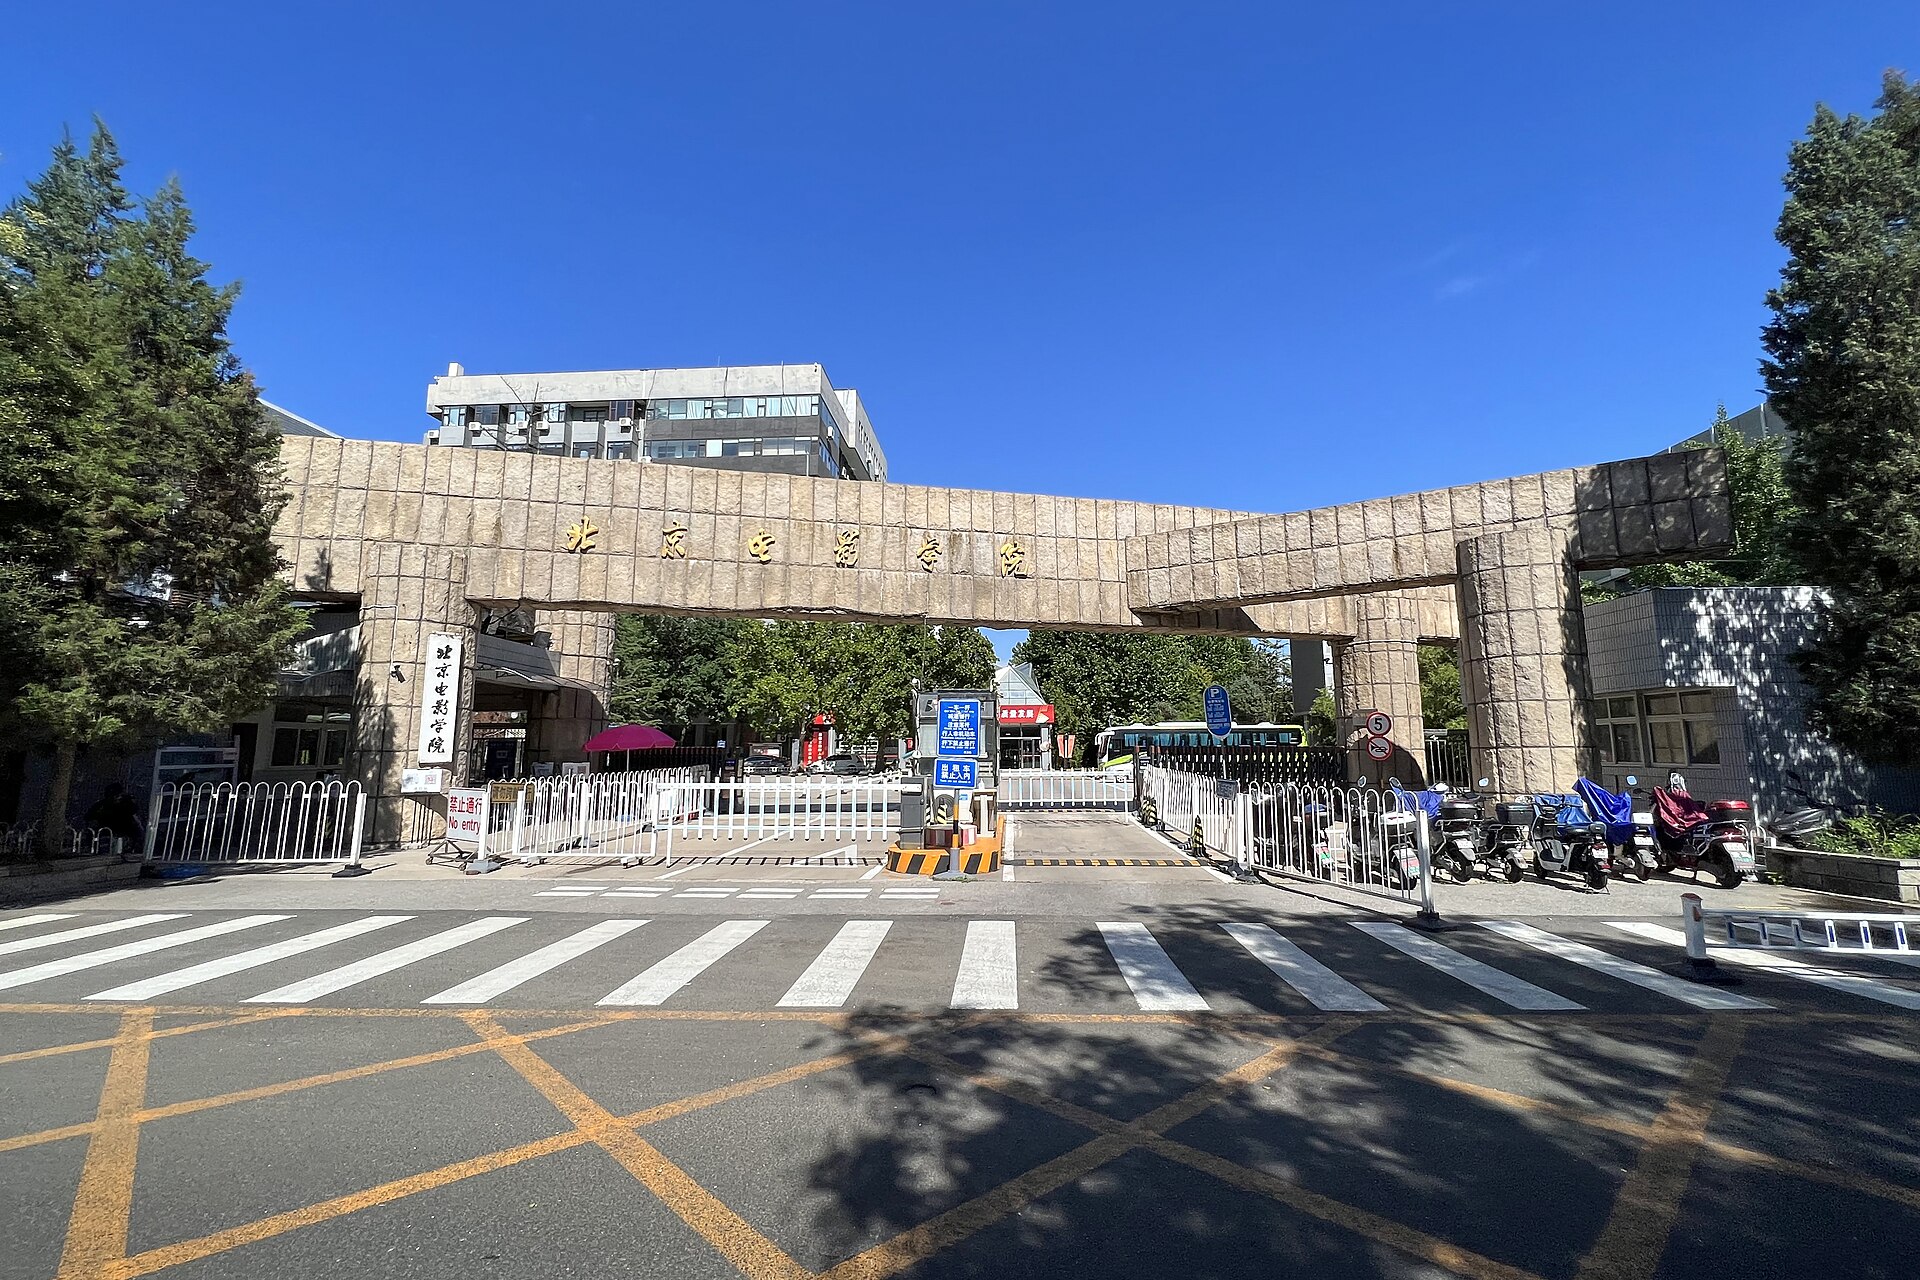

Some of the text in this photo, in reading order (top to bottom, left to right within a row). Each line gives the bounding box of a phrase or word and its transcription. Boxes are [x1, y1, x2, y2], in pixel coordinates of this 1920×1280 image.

[566, 517, 1034, 578] 北京电影学院
[427, 644, 453, 754] 北京电影学院
[1374, 718, 1383, 730] 5
[941, 764, 970, 772] 出租车
[941, 771, 971, 780] 禁止入内
[449, 796, 483, 815] 禁止通行
[449, 816, 481, 835] No entry
